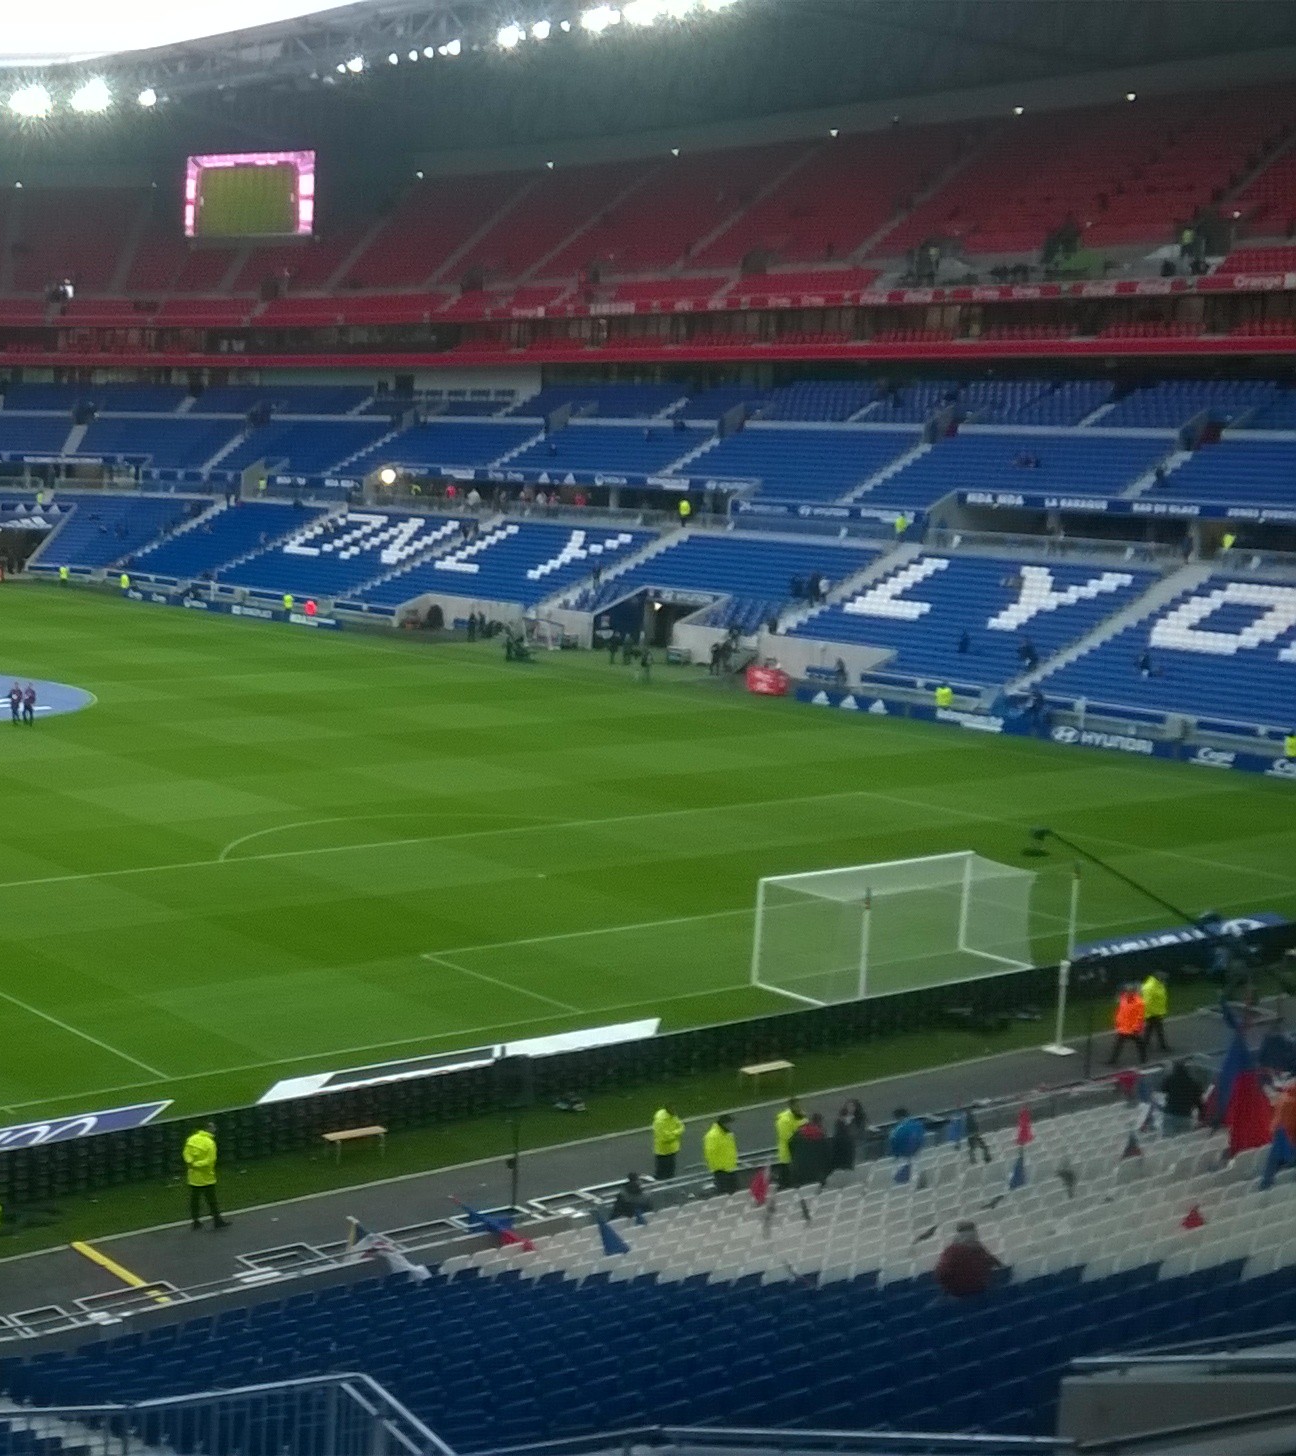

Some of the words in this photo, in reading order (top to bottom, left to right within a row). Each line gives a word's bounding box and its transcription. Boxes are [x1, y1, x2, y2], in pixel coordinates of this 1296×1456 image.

[283, 512, 633, 579] ONLY
[843, 557, 1296, 663] LYO
[1081, 732, 1153, 754] HYUNDAI
